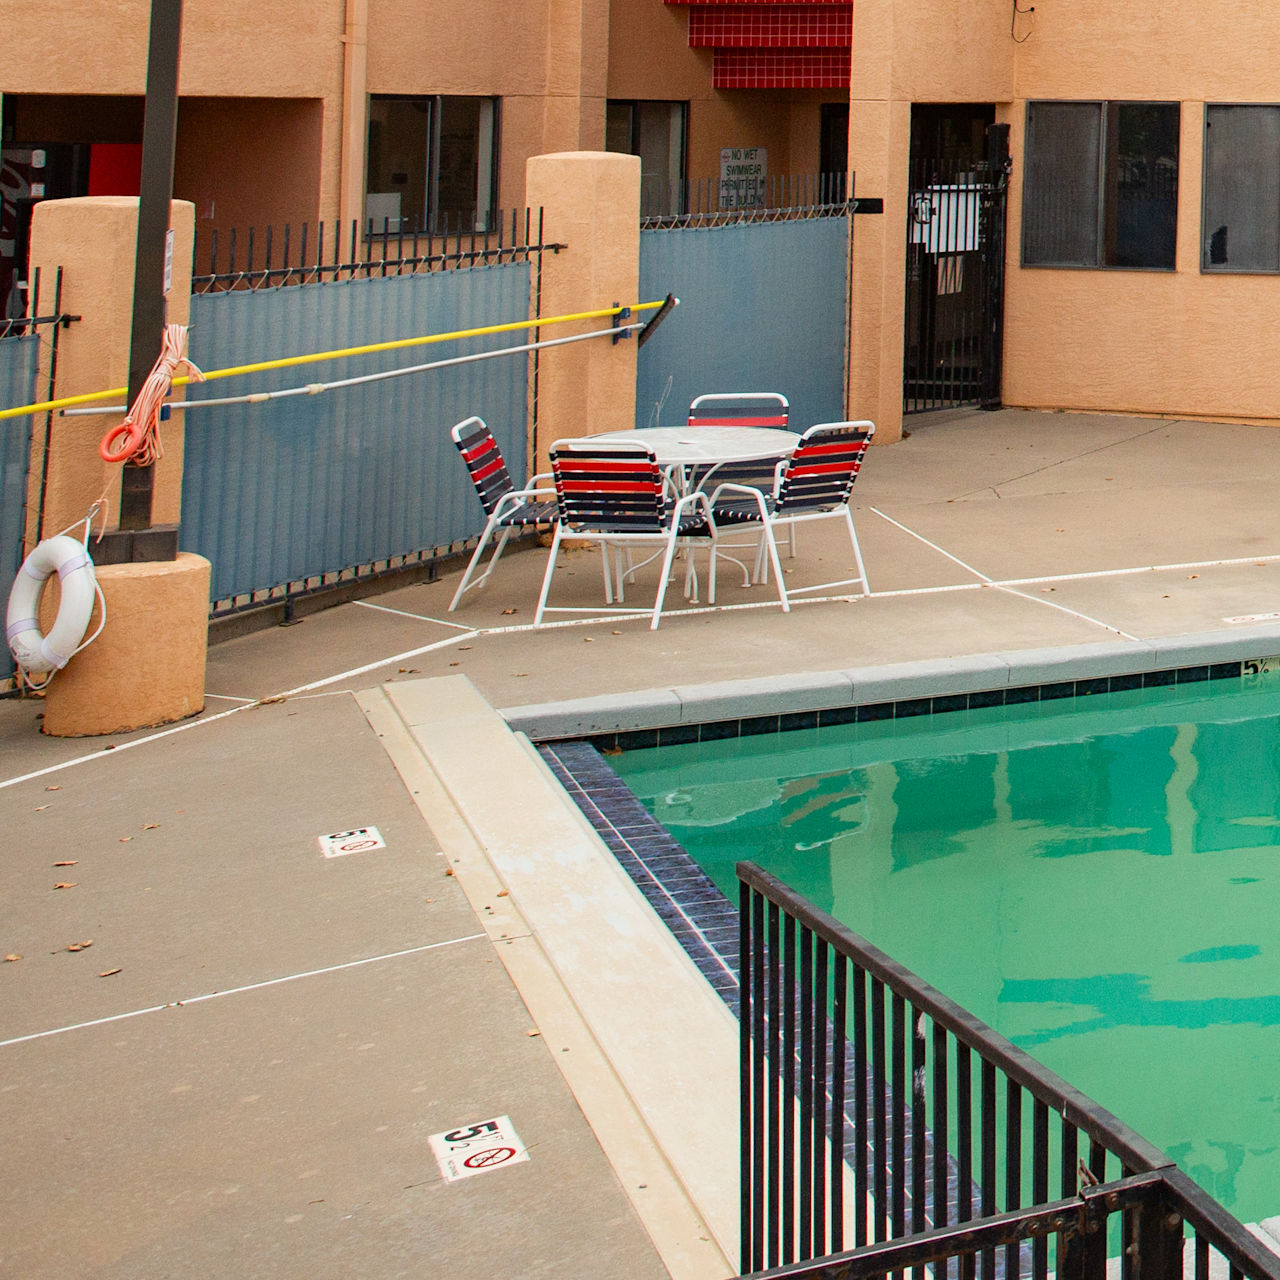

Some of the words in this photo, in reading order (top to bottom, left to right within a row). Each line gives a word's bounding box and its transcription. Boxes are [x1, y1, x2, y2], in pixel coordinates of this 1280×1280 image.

[731, 149, 741, 160] NO
[744, 149, 758, 160] WET
[726, 164, 762, 176] SWIMWEAR
[721, 195, 734, 207] TE
